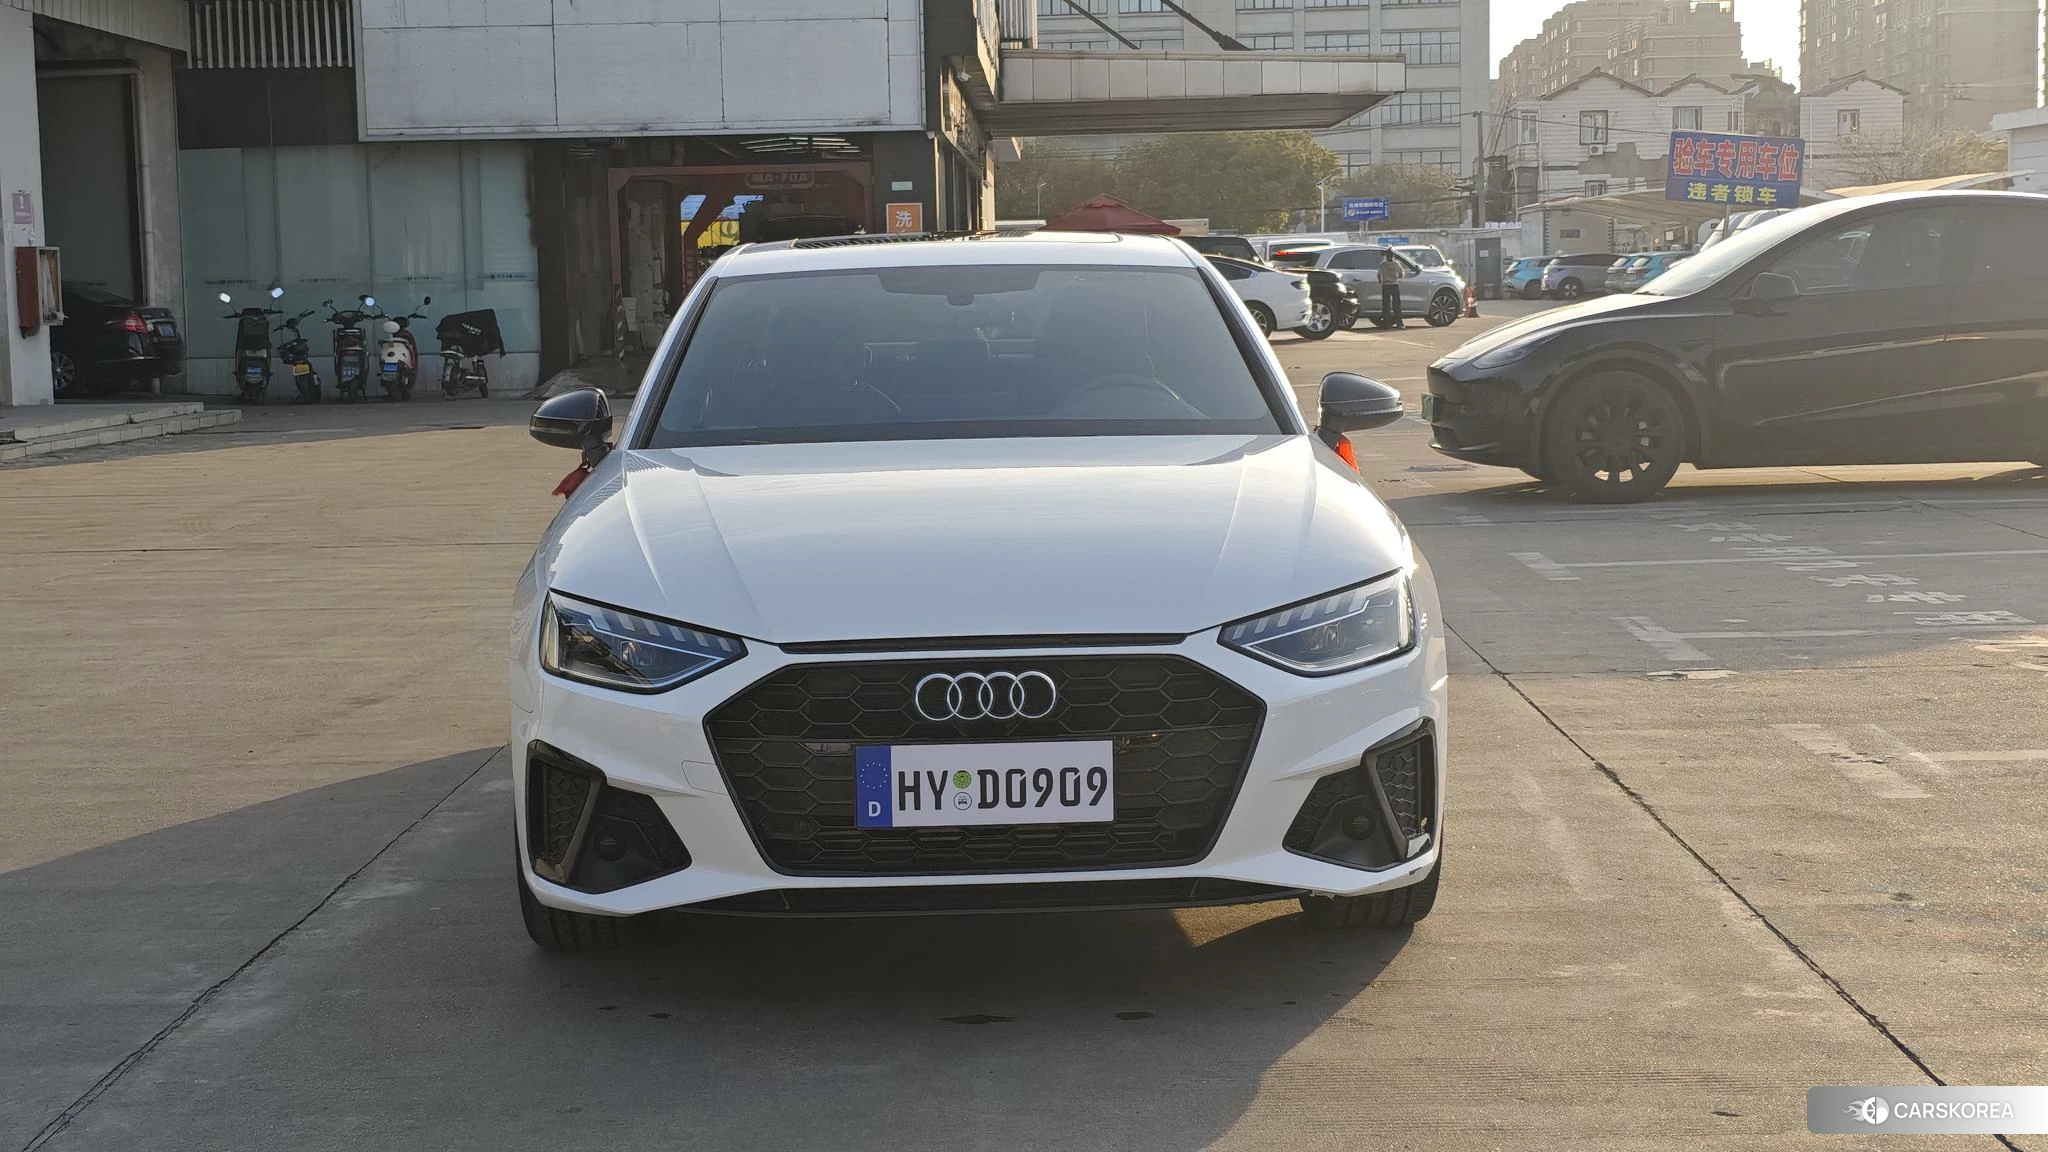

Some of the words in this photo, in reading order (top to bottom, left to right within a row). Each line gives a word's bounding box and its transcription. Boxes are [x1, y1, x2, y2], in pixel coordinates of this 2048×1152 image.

[1673, 137, 1799, 181] 验车专用车位
[1687, 182, 1777, 204] 违者锁车
[898, 770, 949, 811] HY
[977, 766, 1108, 810] D0909
[868, 801, 881, 817] D
